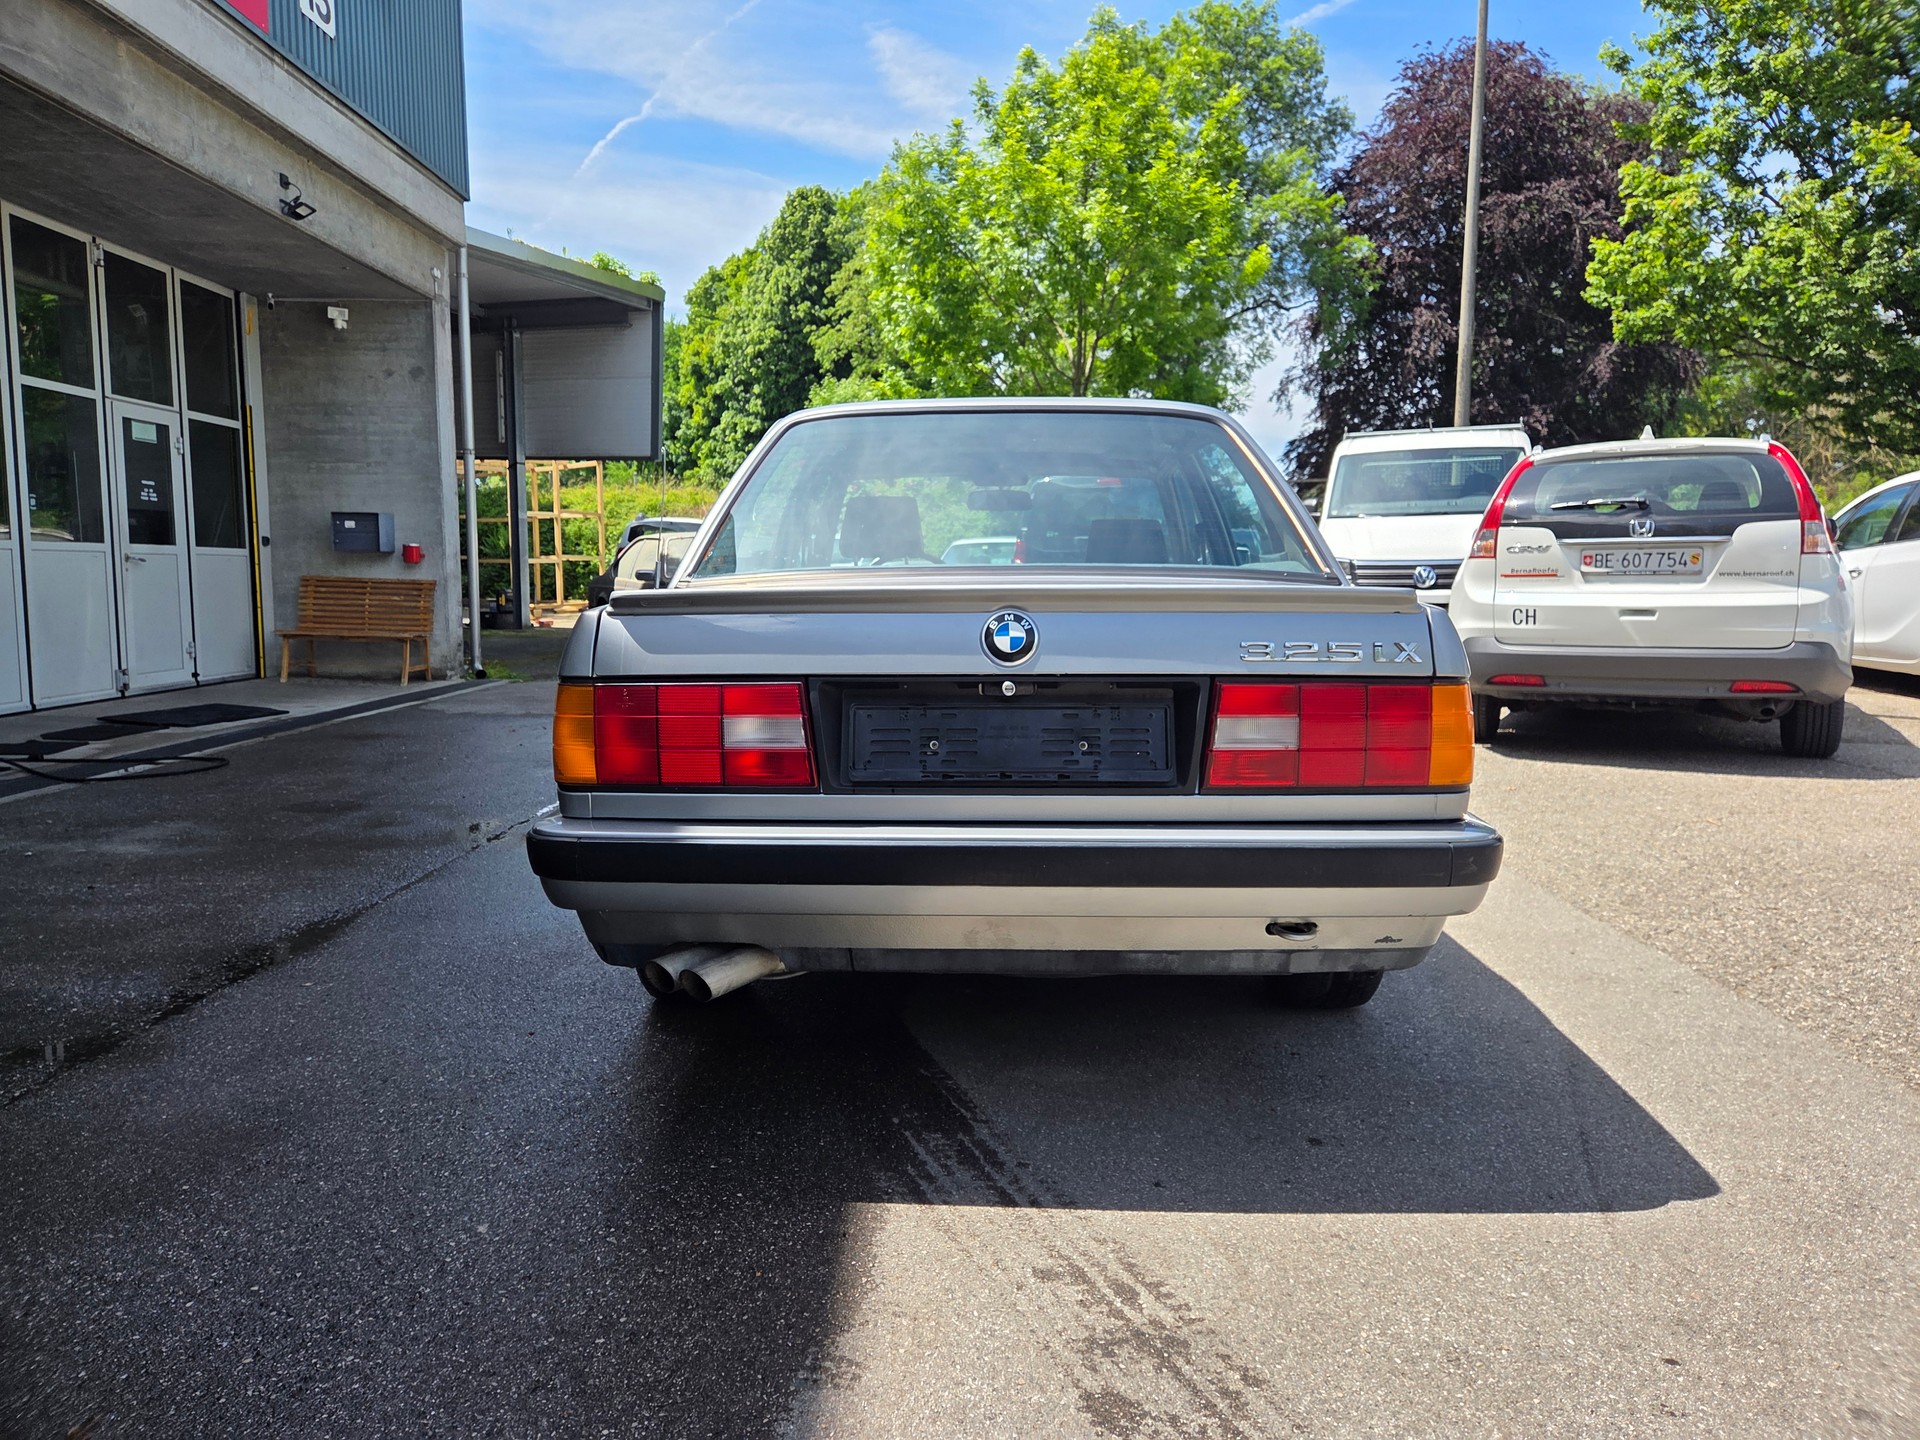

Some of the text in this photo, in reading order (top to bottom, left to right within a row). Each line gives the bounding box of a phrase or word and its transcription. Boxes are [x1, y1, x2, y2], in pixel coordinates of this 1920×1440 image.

[1594, 552, 1688, 569] BE 607754
[989, 614, 1032, 630] BMW
[1512, 608, 1537, 626] CH
